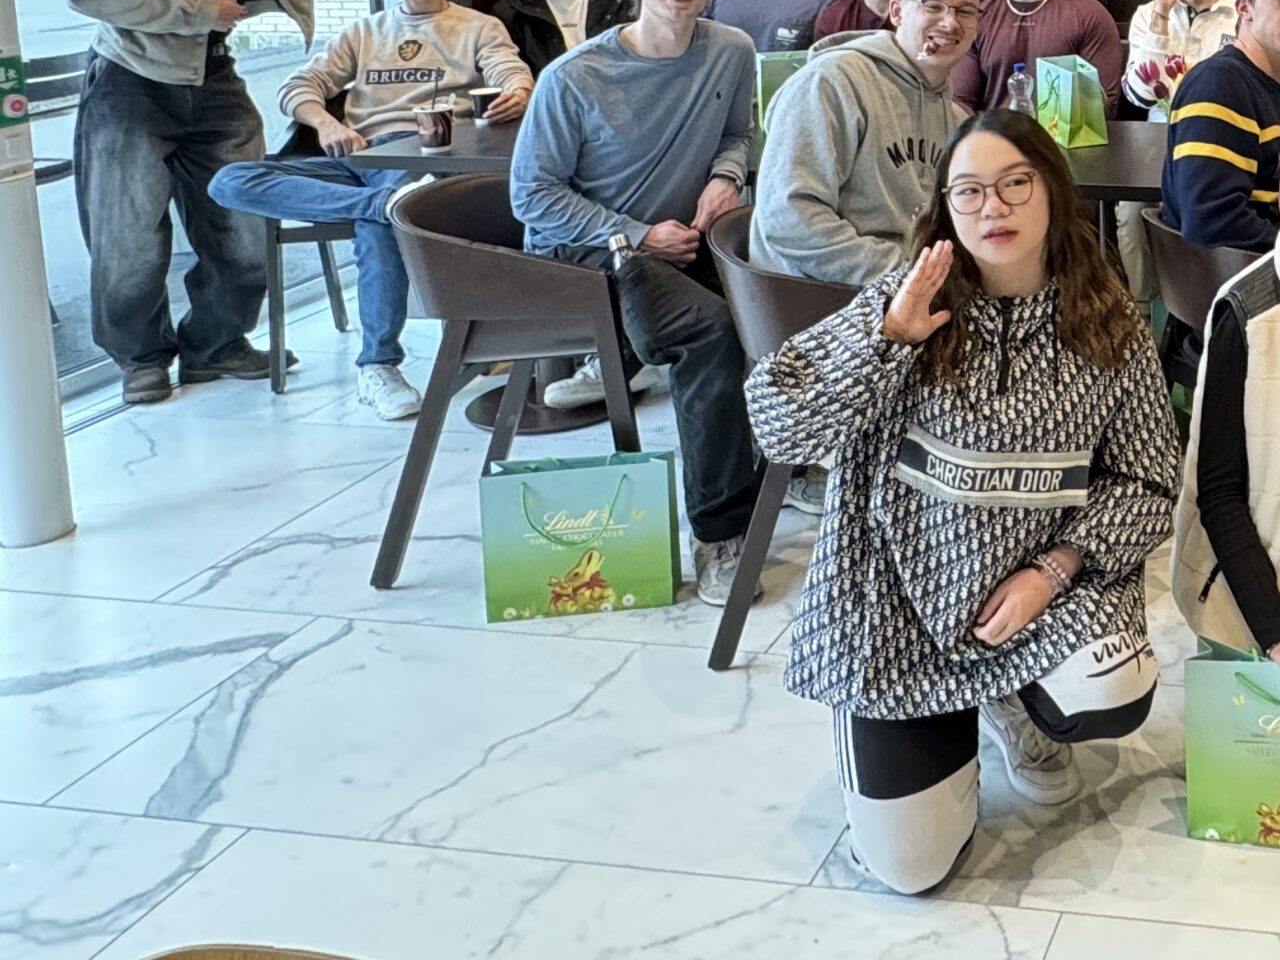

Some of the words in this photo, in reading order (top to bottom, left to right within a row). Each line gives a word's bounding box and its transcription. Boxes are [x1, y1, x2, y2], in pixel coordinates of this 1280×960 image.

[925, 454, 1016, 491] CHRISTIAN
[1019, 469, 1063, 491] DIOR
[543, 510, 600, 531] Lindt
